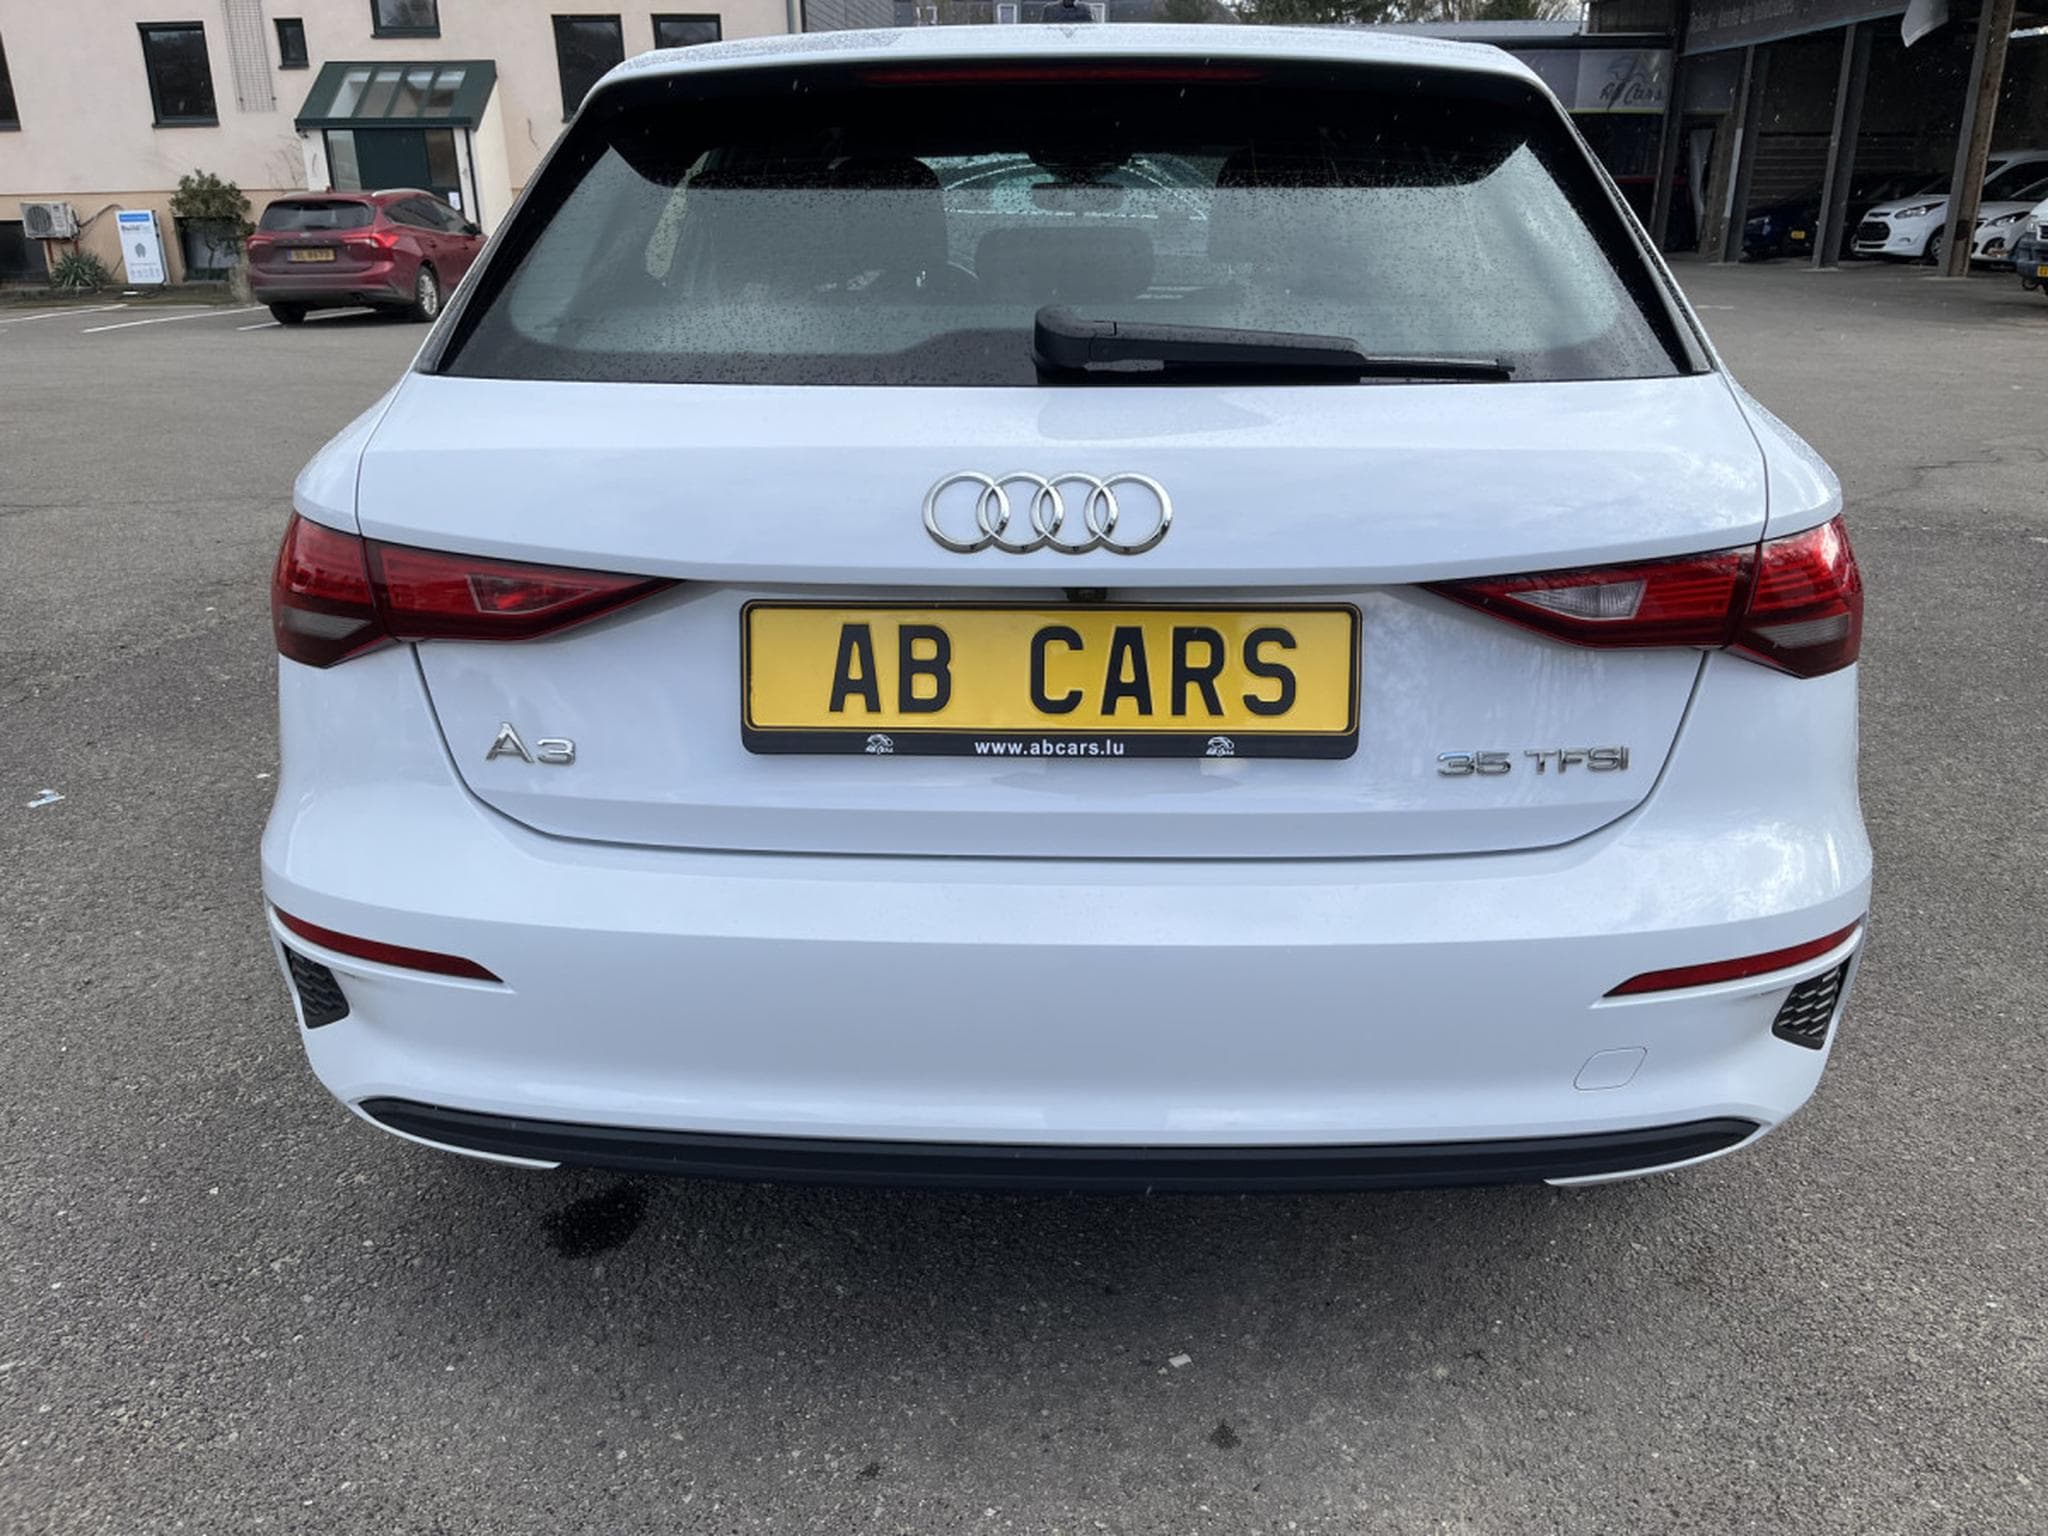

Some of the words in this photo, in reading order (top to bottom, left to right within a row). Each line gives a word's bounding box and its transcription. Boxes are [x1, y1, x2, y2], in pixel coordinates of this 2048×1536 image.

[829, 623, 951, 713] AB
[1030, 625, 1298, 716] CARS
[486, 721, 576, 765] A3
[974, 738, 1125, 756] www.abcars.lu
[1438, 750, 1511, 777] 35
[1524, 746, 1630, 774] TFSI
